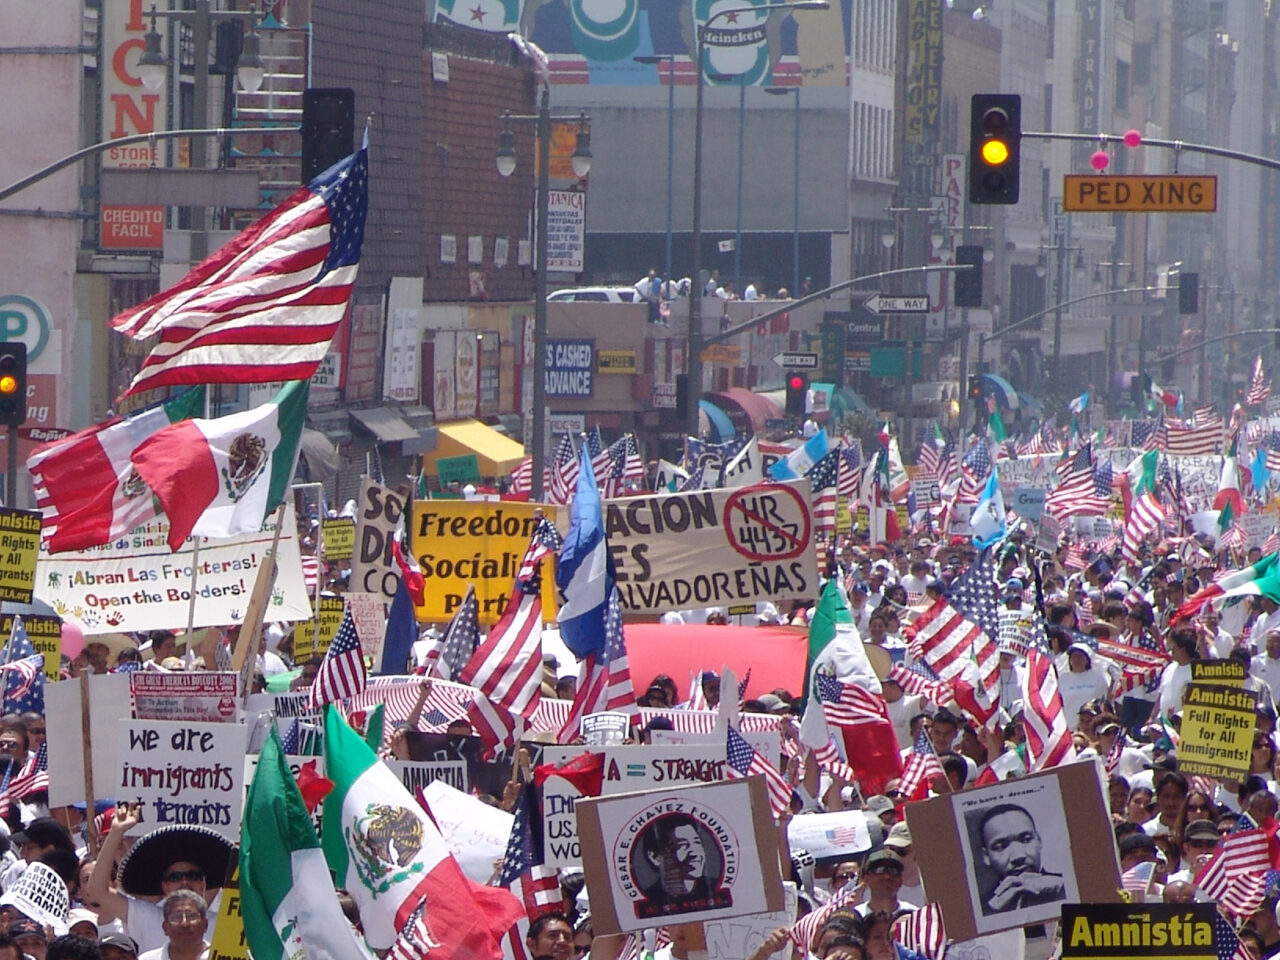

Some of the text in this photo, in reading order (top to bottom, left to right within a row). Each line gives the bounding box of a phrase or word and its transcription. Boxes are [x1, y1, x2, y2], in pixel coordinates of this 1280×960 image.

[704, 30, 763, 44] Heineken
[110, 147, 158, 162] STORE
[1079, 182, 1204, 206] PED XING
[103, 208, 163, 223] CREDITO
[111, 224, 152, 238] FACIL
[878, 301, 925, 310] ONE WAY
[849, 322, 880, 334] Central
[556, 344, 591, 368] CASHED
[545, 370, 590, 395] ADVANCE
[28, 428, 70, 443] Rapid
[742, 494, 780, 525] HR
[1, 534, 36, 551] Rights
[739, 526, 798, 554] 4437
[6, 553, 22, 566] All
[68, 569, 124, 588] ¡Abran
[128, 567, 158, 583] Las
[84, 592, 132, 611] Open
[132, 588, 163, 606] the
[1189, 687, 1255, 710] Amnistía
[172, 727, 215, 752] are
[122, 761, 234, 796] immigrants
[617, 855, 637, 898] CESAR
[629, 803, 684, 834] CHAVEZ
[690, 806, 736, 890] FOUNDATION
[1070, 911, 1212, 948] Amnistía
